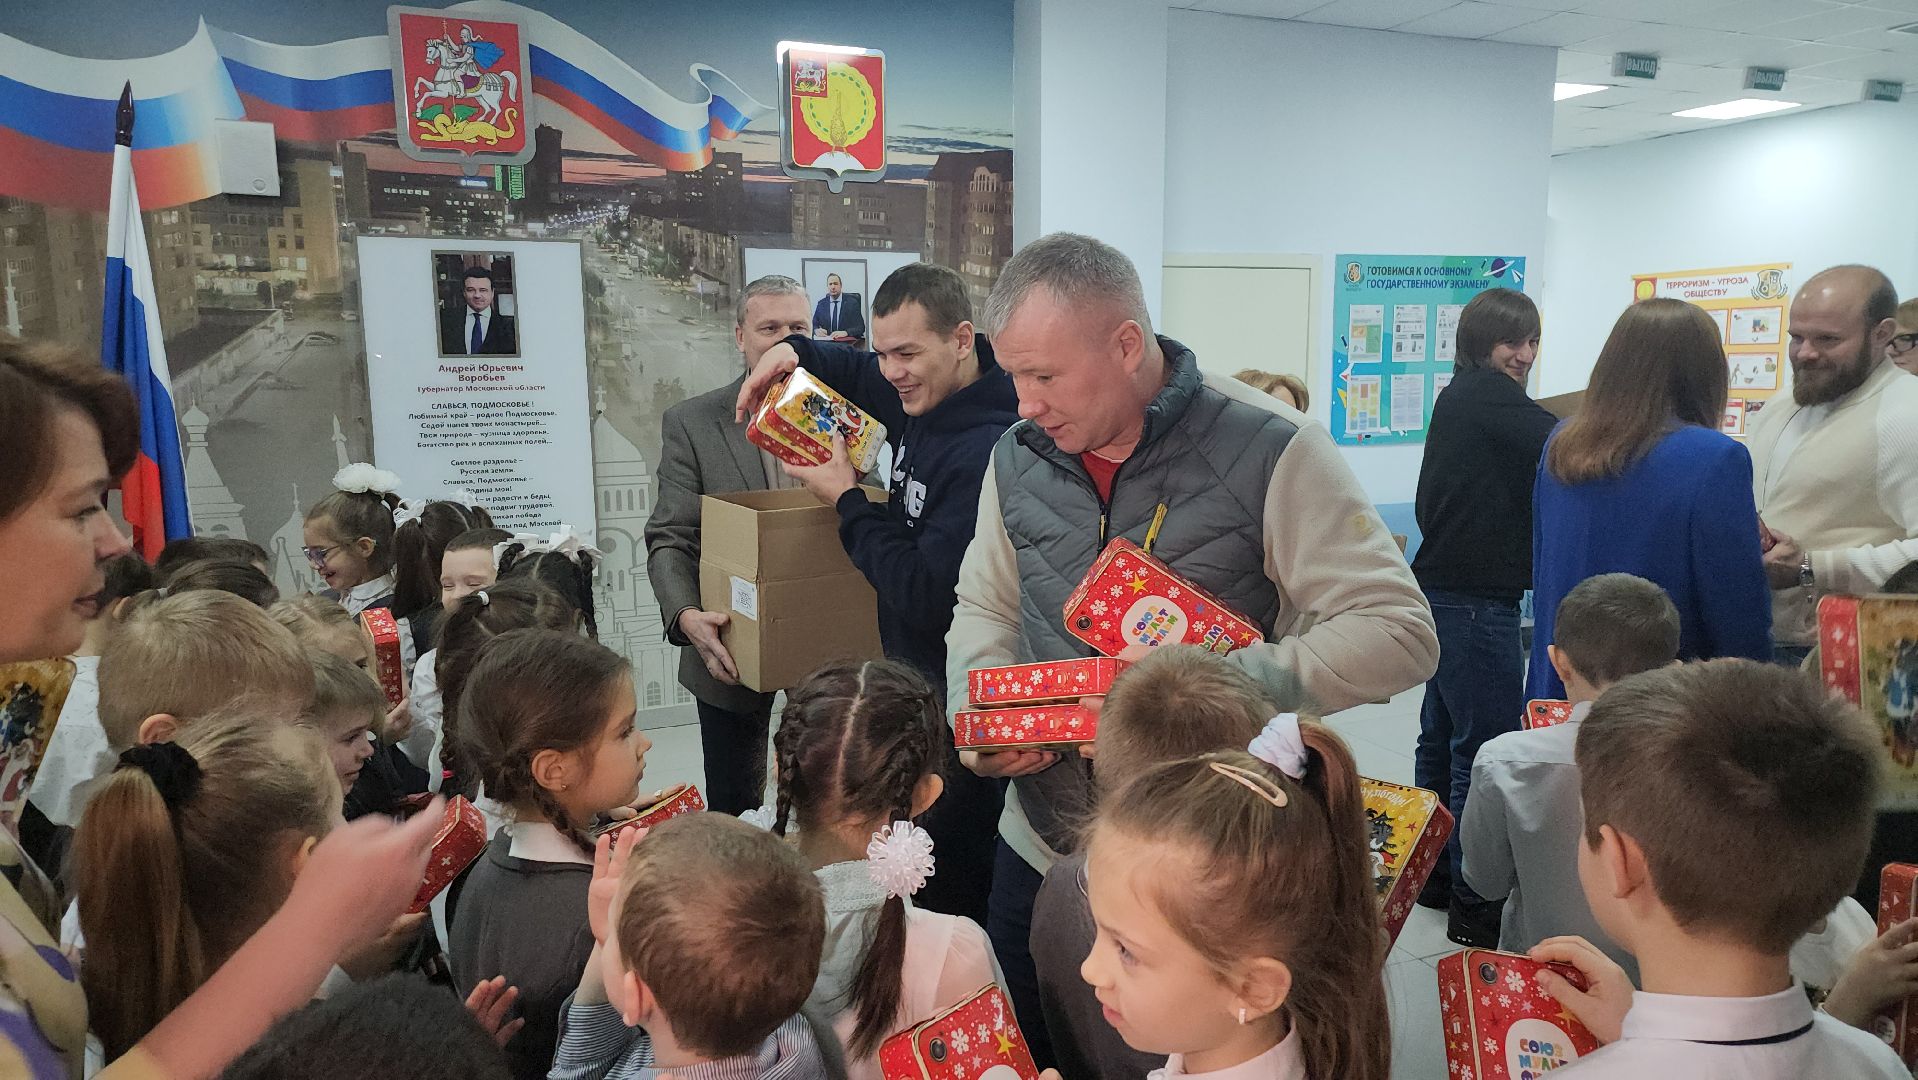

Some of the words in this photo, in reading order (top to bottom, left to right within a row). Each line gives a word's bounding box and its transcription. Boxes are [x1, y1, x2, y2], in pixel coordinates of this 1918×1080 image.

[1626, 56, 1657, 76] ВЫХОД
[1755, 70, 1784, 86] ВЫХОД
[1367, 266, 1415, 276] ГОТОВИМСЯ
[1416, 266, 1423, 276] К
[1424, 266, 1473, 277] ОСНОВНОМУ
[1366, 279, 1449, 290] ГОСУДАРСТВЕННОМУ
[1450, 279, 1490, 289] ЭКЗАМЕНУ
[1666, 279, 1710, 289] ТЕРРОРИЗМ
[1717, 276, 1749, 286] УГРОЗА
[1684, 288, 1728, 298] ОБЩЕСТВУ
[438, 364, 476, 374] Андрей
[478, 364, 524, 373] Юрьевич
[458, 374, 505, 383] Воробьев
[1519, 1038, 1564, 1058] СОЮЗ
